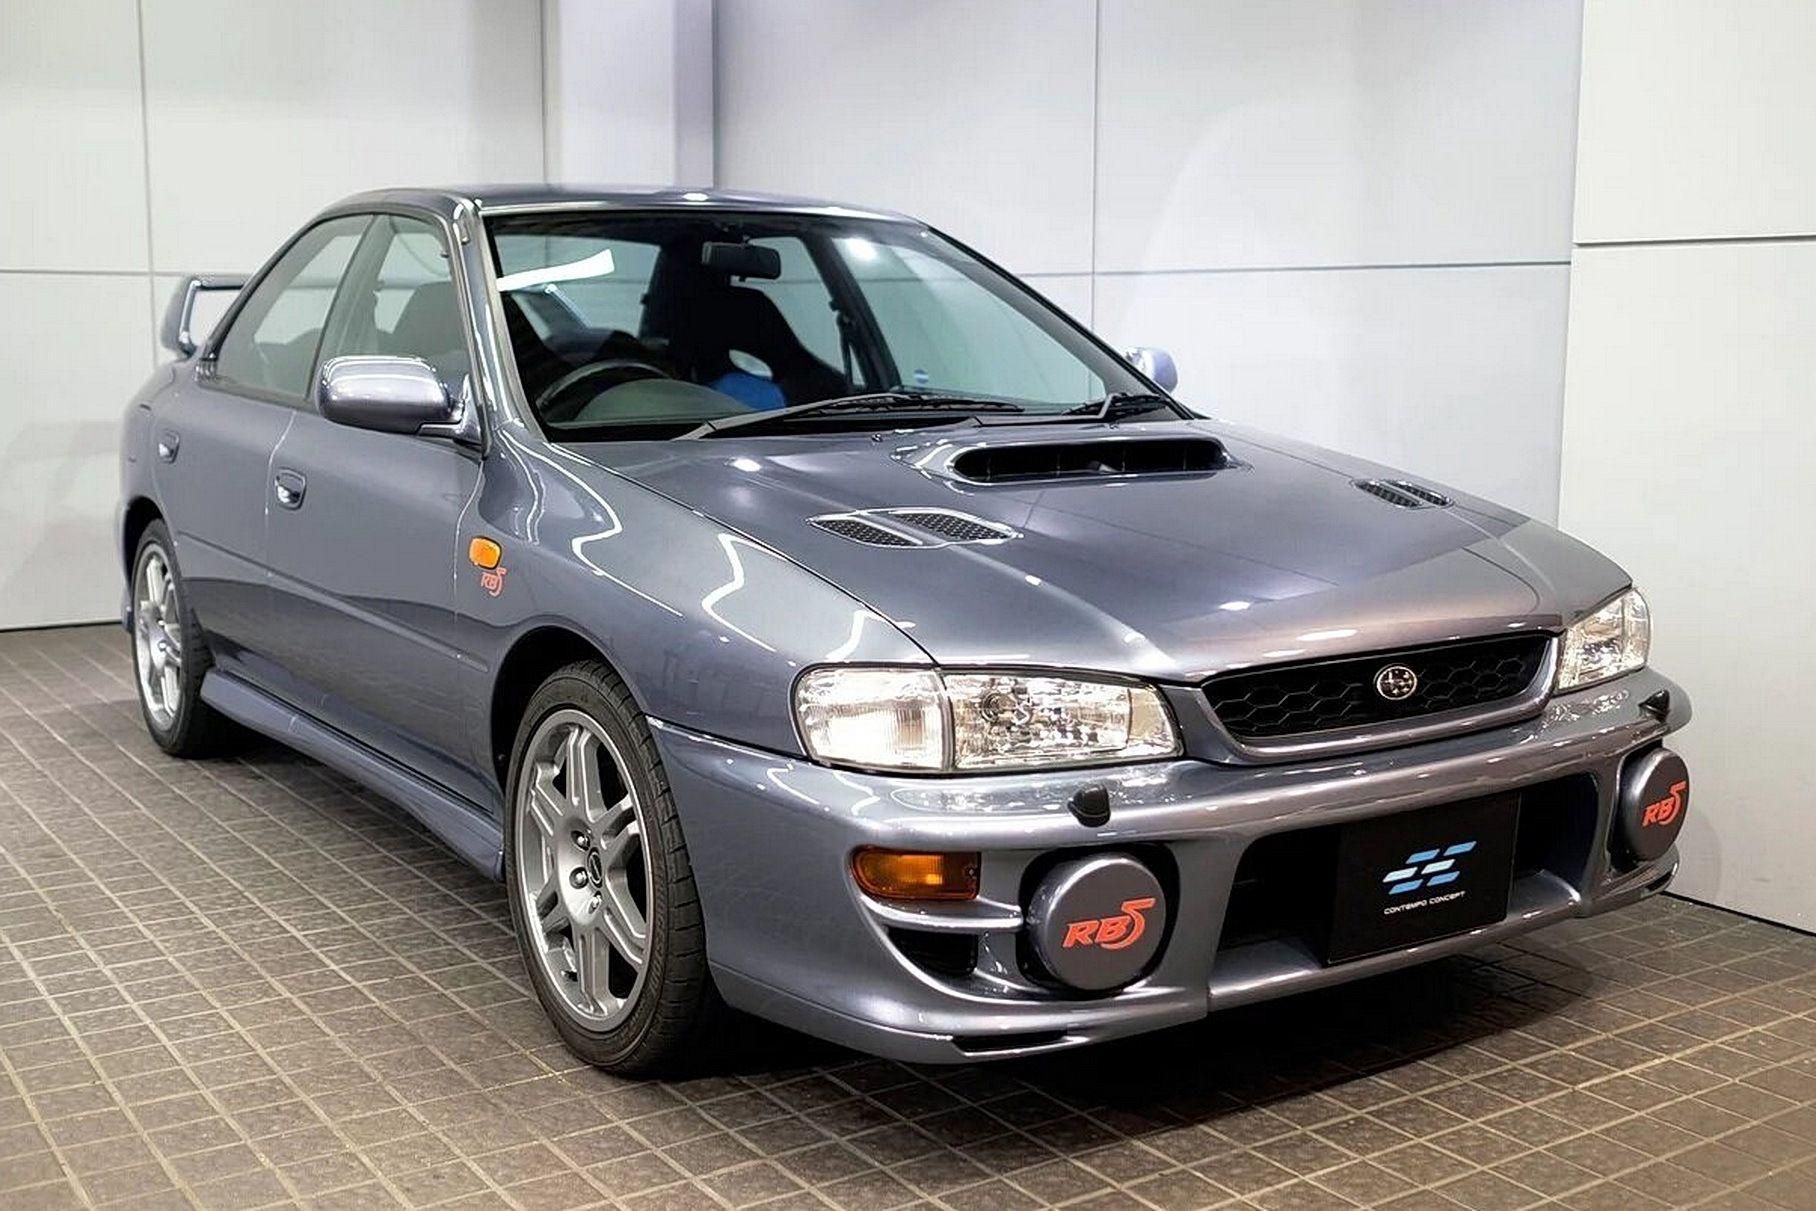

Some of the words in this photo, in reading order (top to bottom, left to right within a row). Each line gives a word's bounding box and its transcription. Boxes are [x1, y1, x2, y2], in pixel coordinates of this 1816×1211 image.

[1642, 781, 1686, 827] RB5
[1063, 898, 1156, 950] RB5
[1384, 900, 1428, 915] CONTEMPO
[1429, 890, 1466, 905] CONCEPT
